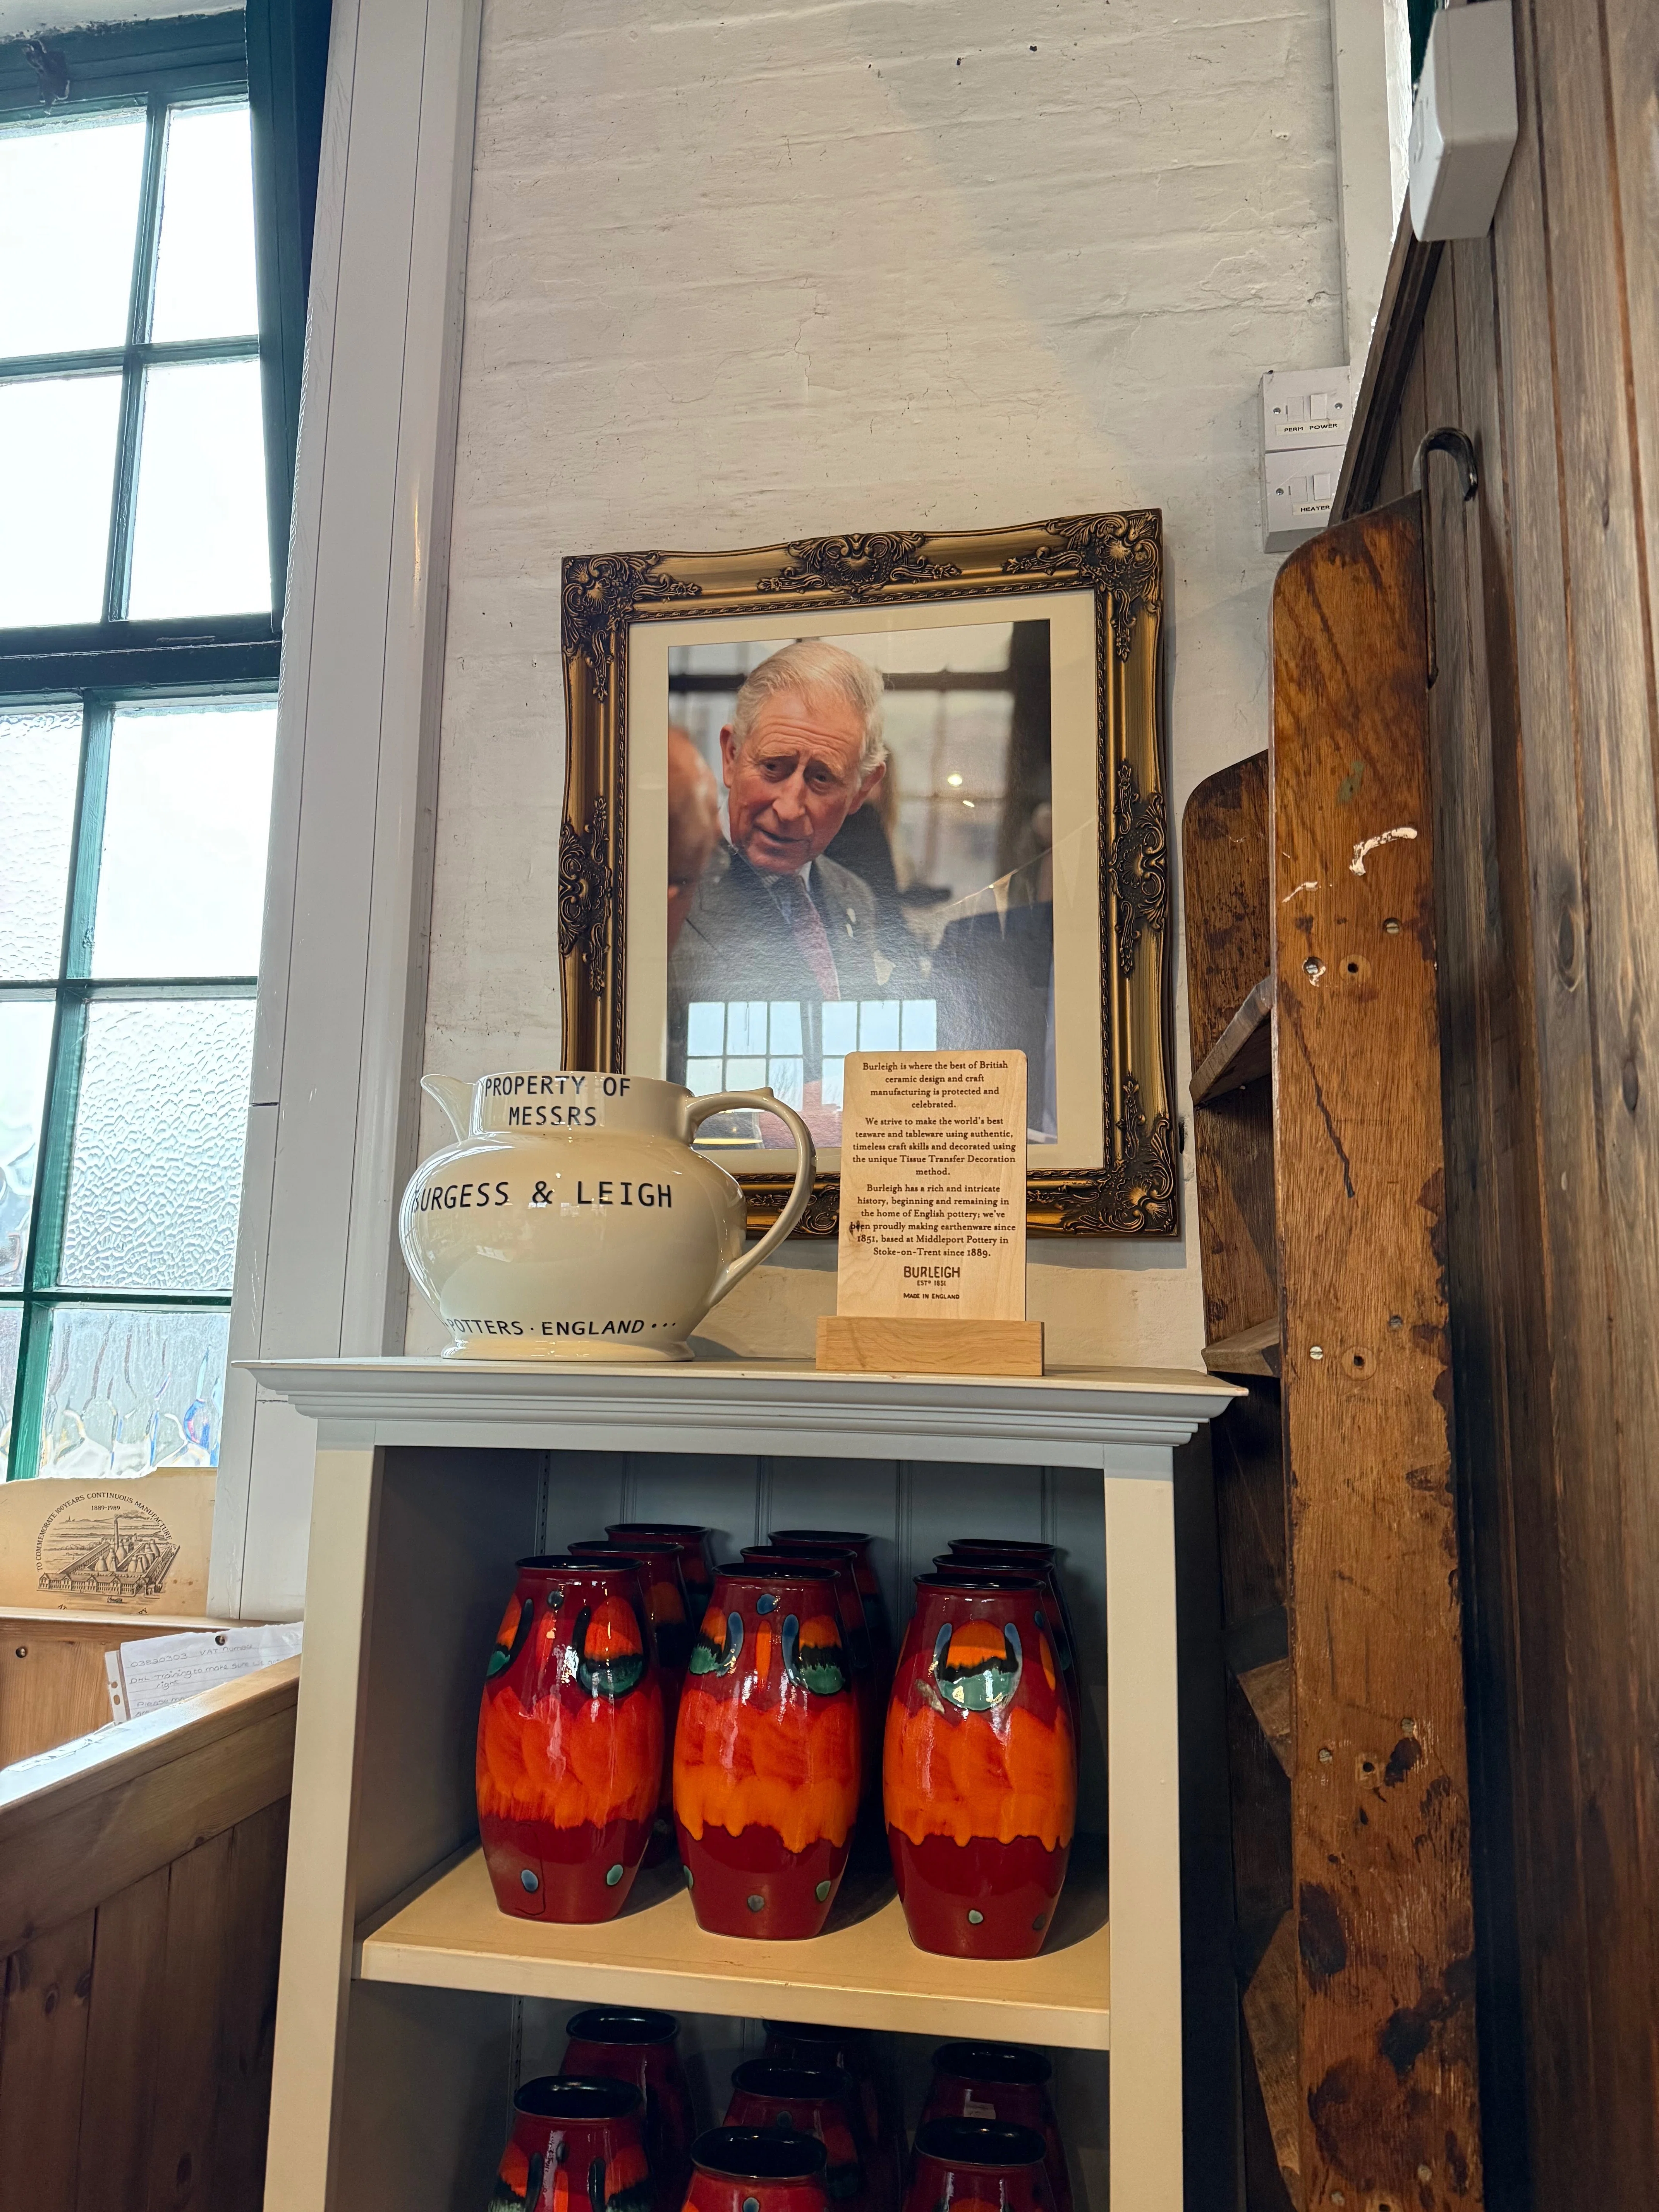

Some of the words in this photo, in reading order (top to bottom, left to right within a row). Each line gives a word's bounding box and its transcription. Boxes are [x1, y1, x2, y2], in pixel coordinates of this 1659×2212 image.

[863, 1062, 898, 1073] Burleigh
[908, 1061, 933, 1070] where
[935, 1061, 948, 1069] the
[950, 1061, 966, 1069] best
[968, 1061, 978, 1069] of
[979, 1060, 1008, 1069] British
[919, 1075, 945, 1085] design
[947, 1074, 963, 1082] and
[965, 1073, 984, 1082] craft
[484, 1075, 585, 1097] PROPERTY
[603, 1076, 630, 1097] OF
[871, 1087, 931, 1098] manufacturing
[941, 1087, 981, 1097] protected
[983, 1086, 1000, 1094] and
[912, 1100, 956, 1108] celebrated.
[508, 1106, 596, 1126] MESSRS
[915, 1117, 936, 1125] make
[939, 1117, 952, 1125] the
[954, 1116, 984, 1125] world's
[987, 1116, 1003, 1125] best
[946, 1130, 969, 1140] using
[970, 1129, 1013, 1138] authentic,
[888, 1142, 907, 1150] craft
[909, 1142, 929, 1150] skills
[931, 1142, 947, 1150] and
[949, 1142, 990, 1150] decorated
[993, 1143, 1016, 1152] using
[868, 1156, 897, 1165] unique
[928, 1154, 965, 1163] Transfer
[915, 1167, 950, 1175] method.
[532, 1181, 553, 1204] &
[577, 1181, 672, 1208] LEIGH
[867, 1184, 902, 1194] Burleigh
[927, 1184, 944, 1192] rich
[857, 1196, 888, 1207] history,
[891, 1196, 934, 1207] beginning
[954, 1198, 998, 1207] remaining
[876, 1209, 900, 1217] home
[902, 1209, 912, 1217] of
[914, 1209, 945, 1220] English
[947, 1211, 980, 1220] pottery;
[850, 1222, 871, 1230] been
[873, 1222, 906, 1232] proudly
[908, 1222, 939, 1233] making
[941, 1222, 991, 1230] earthenware
[857, 1234, 878, 1244] 1851,
[881, 1234, 904, 1242] based
[916, 1235, 964, 1245] Middleport
[967, 1235, 997, 1246] Pottery
[873, 1247, 941, 1256] Stoke-on-Trent
[967, 1248, 991, 1258] 1889.
[903, 1266, 960, 1278] BURLEIGH
[87, 1492, 134, 1504] CONTINUOUS
[135, 1501, 172, 1541] MANUFACTURE
[36, 1512, 57, 1561] COMMEMORATE
[36, 1562, 43, 1572] TO
